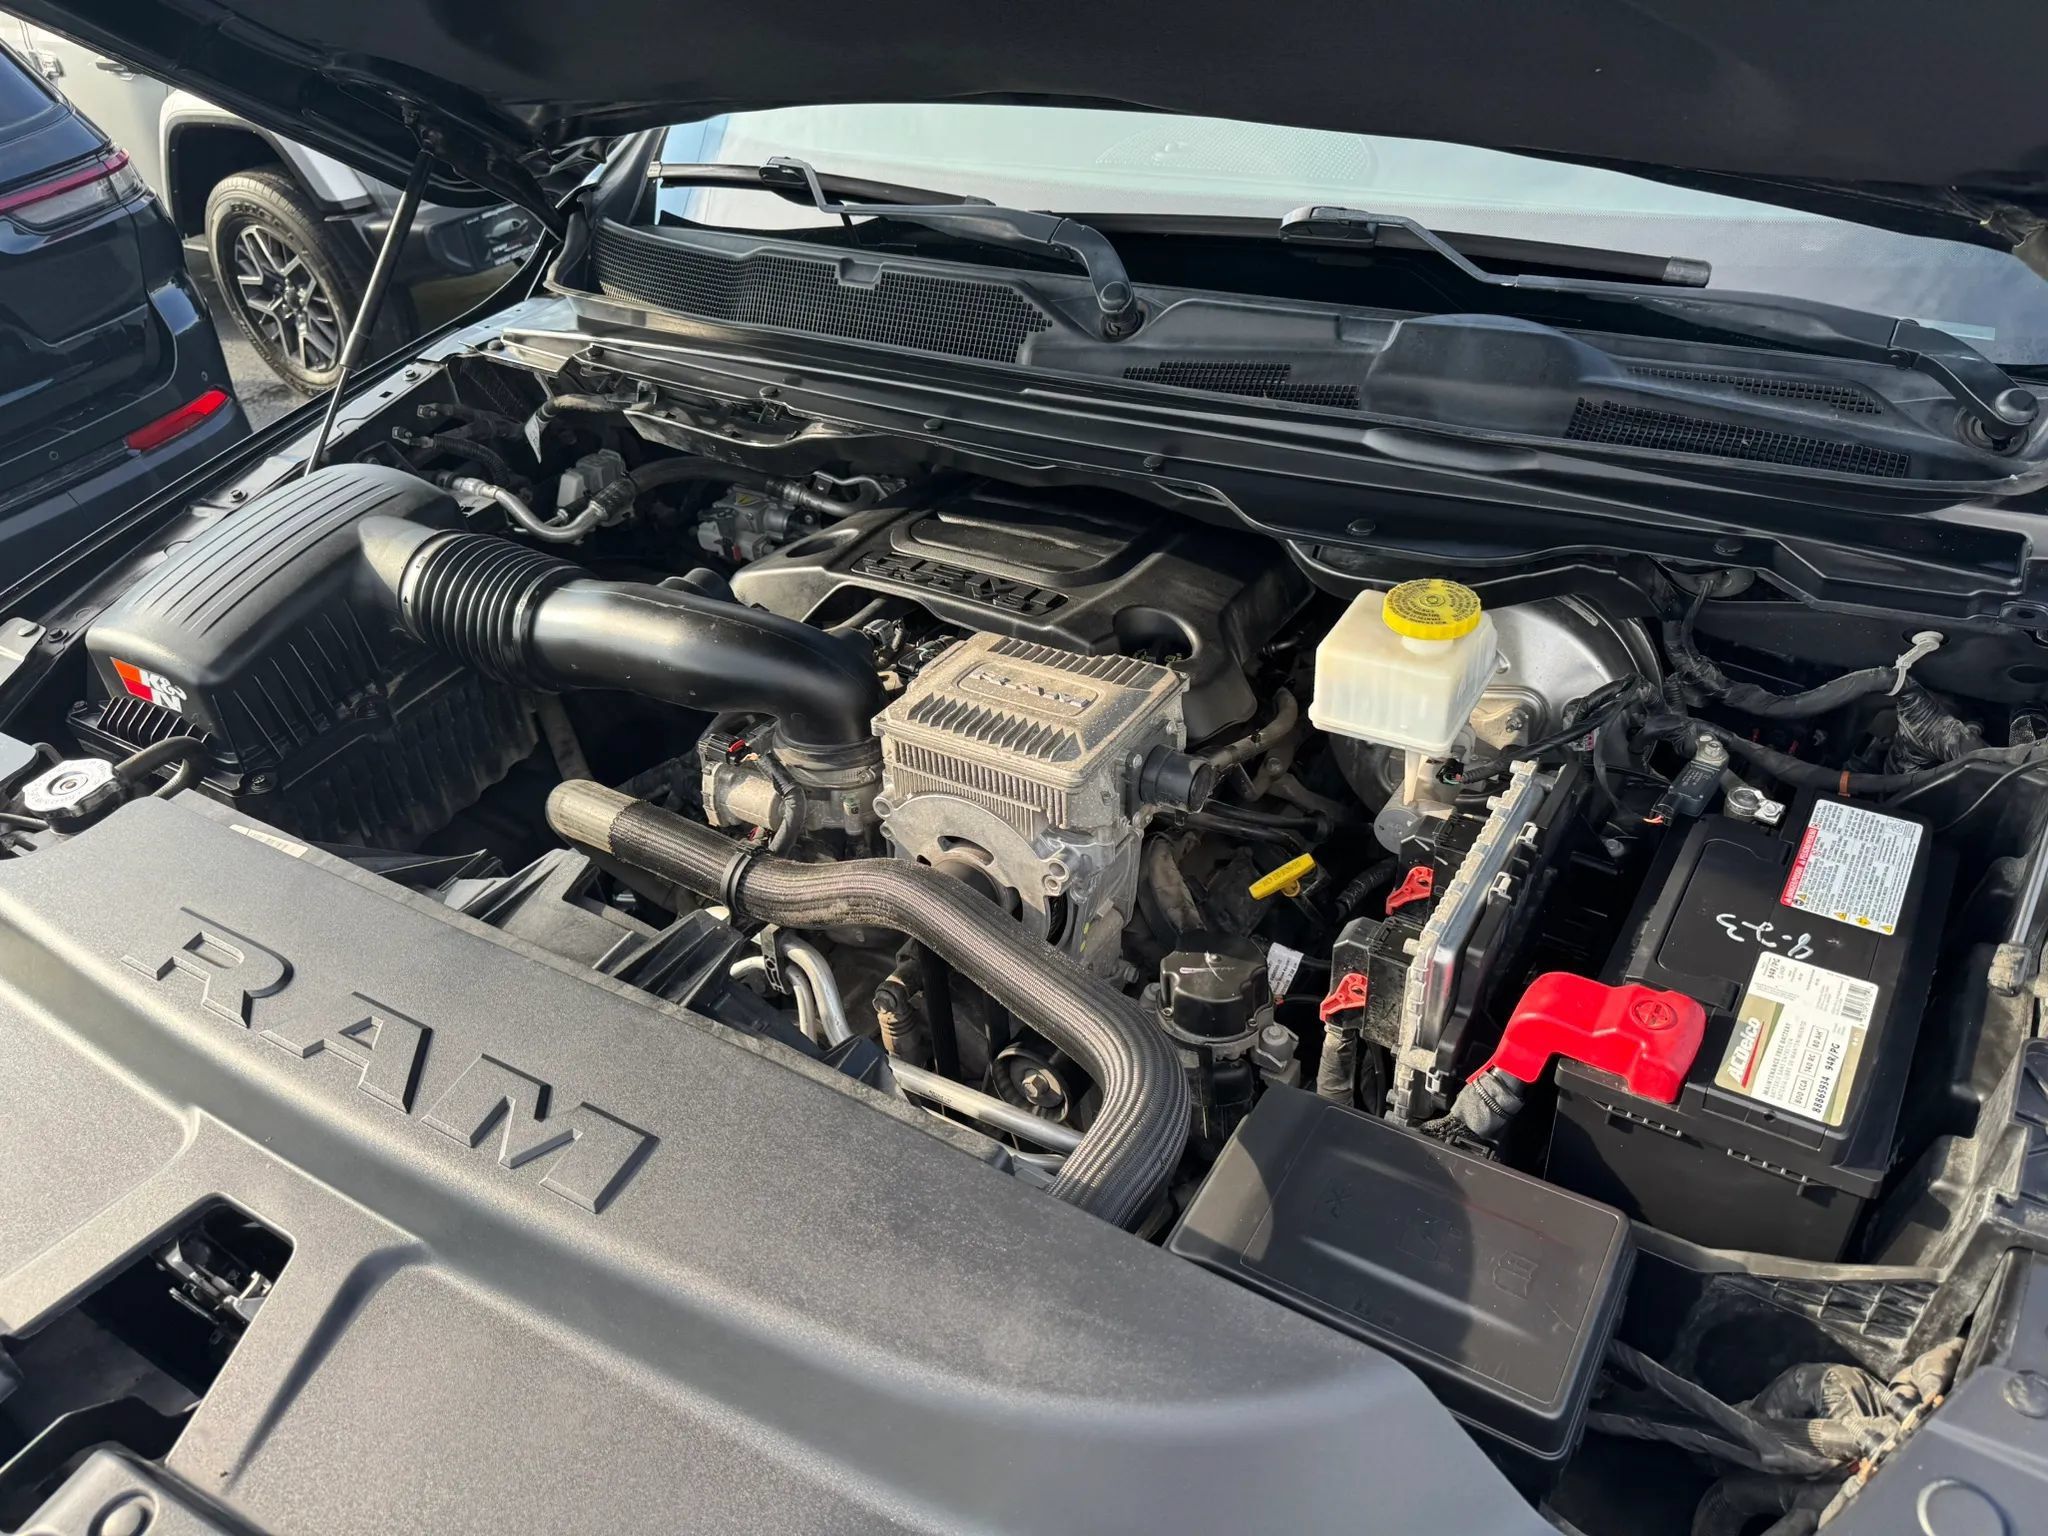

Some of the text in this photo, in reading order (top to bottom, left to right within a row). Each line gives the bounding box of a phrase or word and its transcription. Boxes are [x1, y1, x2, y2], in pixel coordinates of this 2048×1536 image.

[121, 906, 659, 1213] RAM
[1726, 1016, 1760, 1083] ACDelco
[1811, 1038, 1820, 1048] 80
[1793, 1078, 1808, 1104] 800 CCA
[1811, 1075, 1830, 1114] 88865934
[1823, 1042, 1842, 1072] 94R/PG
